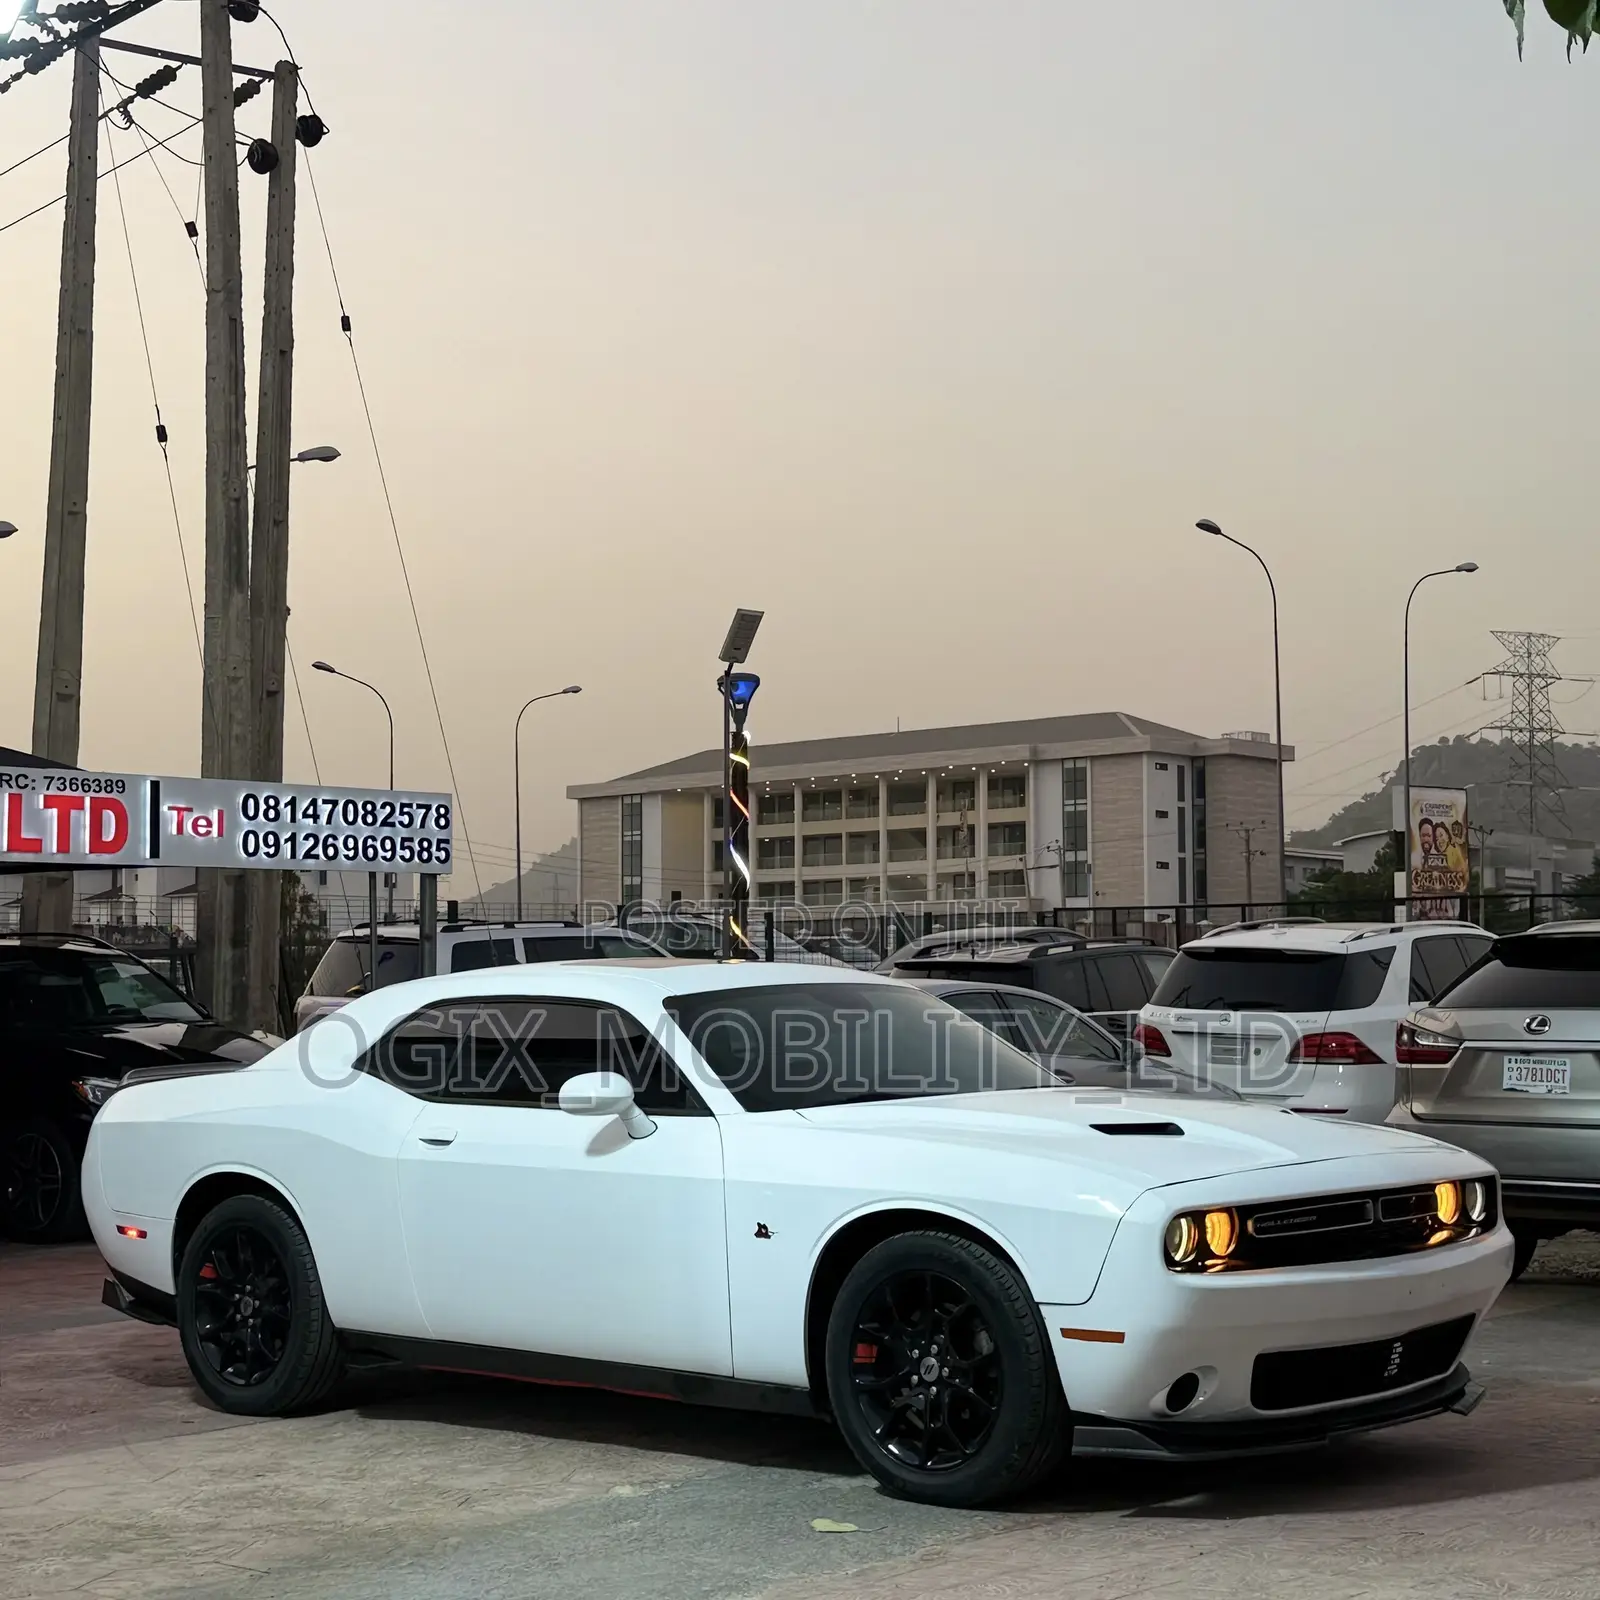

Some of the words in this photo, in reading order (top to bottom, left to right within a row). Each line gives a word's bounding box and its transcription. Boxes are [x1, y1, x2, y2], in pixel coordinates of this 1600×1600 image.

[0, 773, 36, 791] RC:
[43, 776, 126, 794] 7366389
[4, 792, 129, 854] LTD
[164, 805, 224, 838] Tel
[240, 793, 450, 830] 08147082578
[240, 829, 450, 864] 09126969585
[1515, 1066, 1567, 1084] 3781DCT
